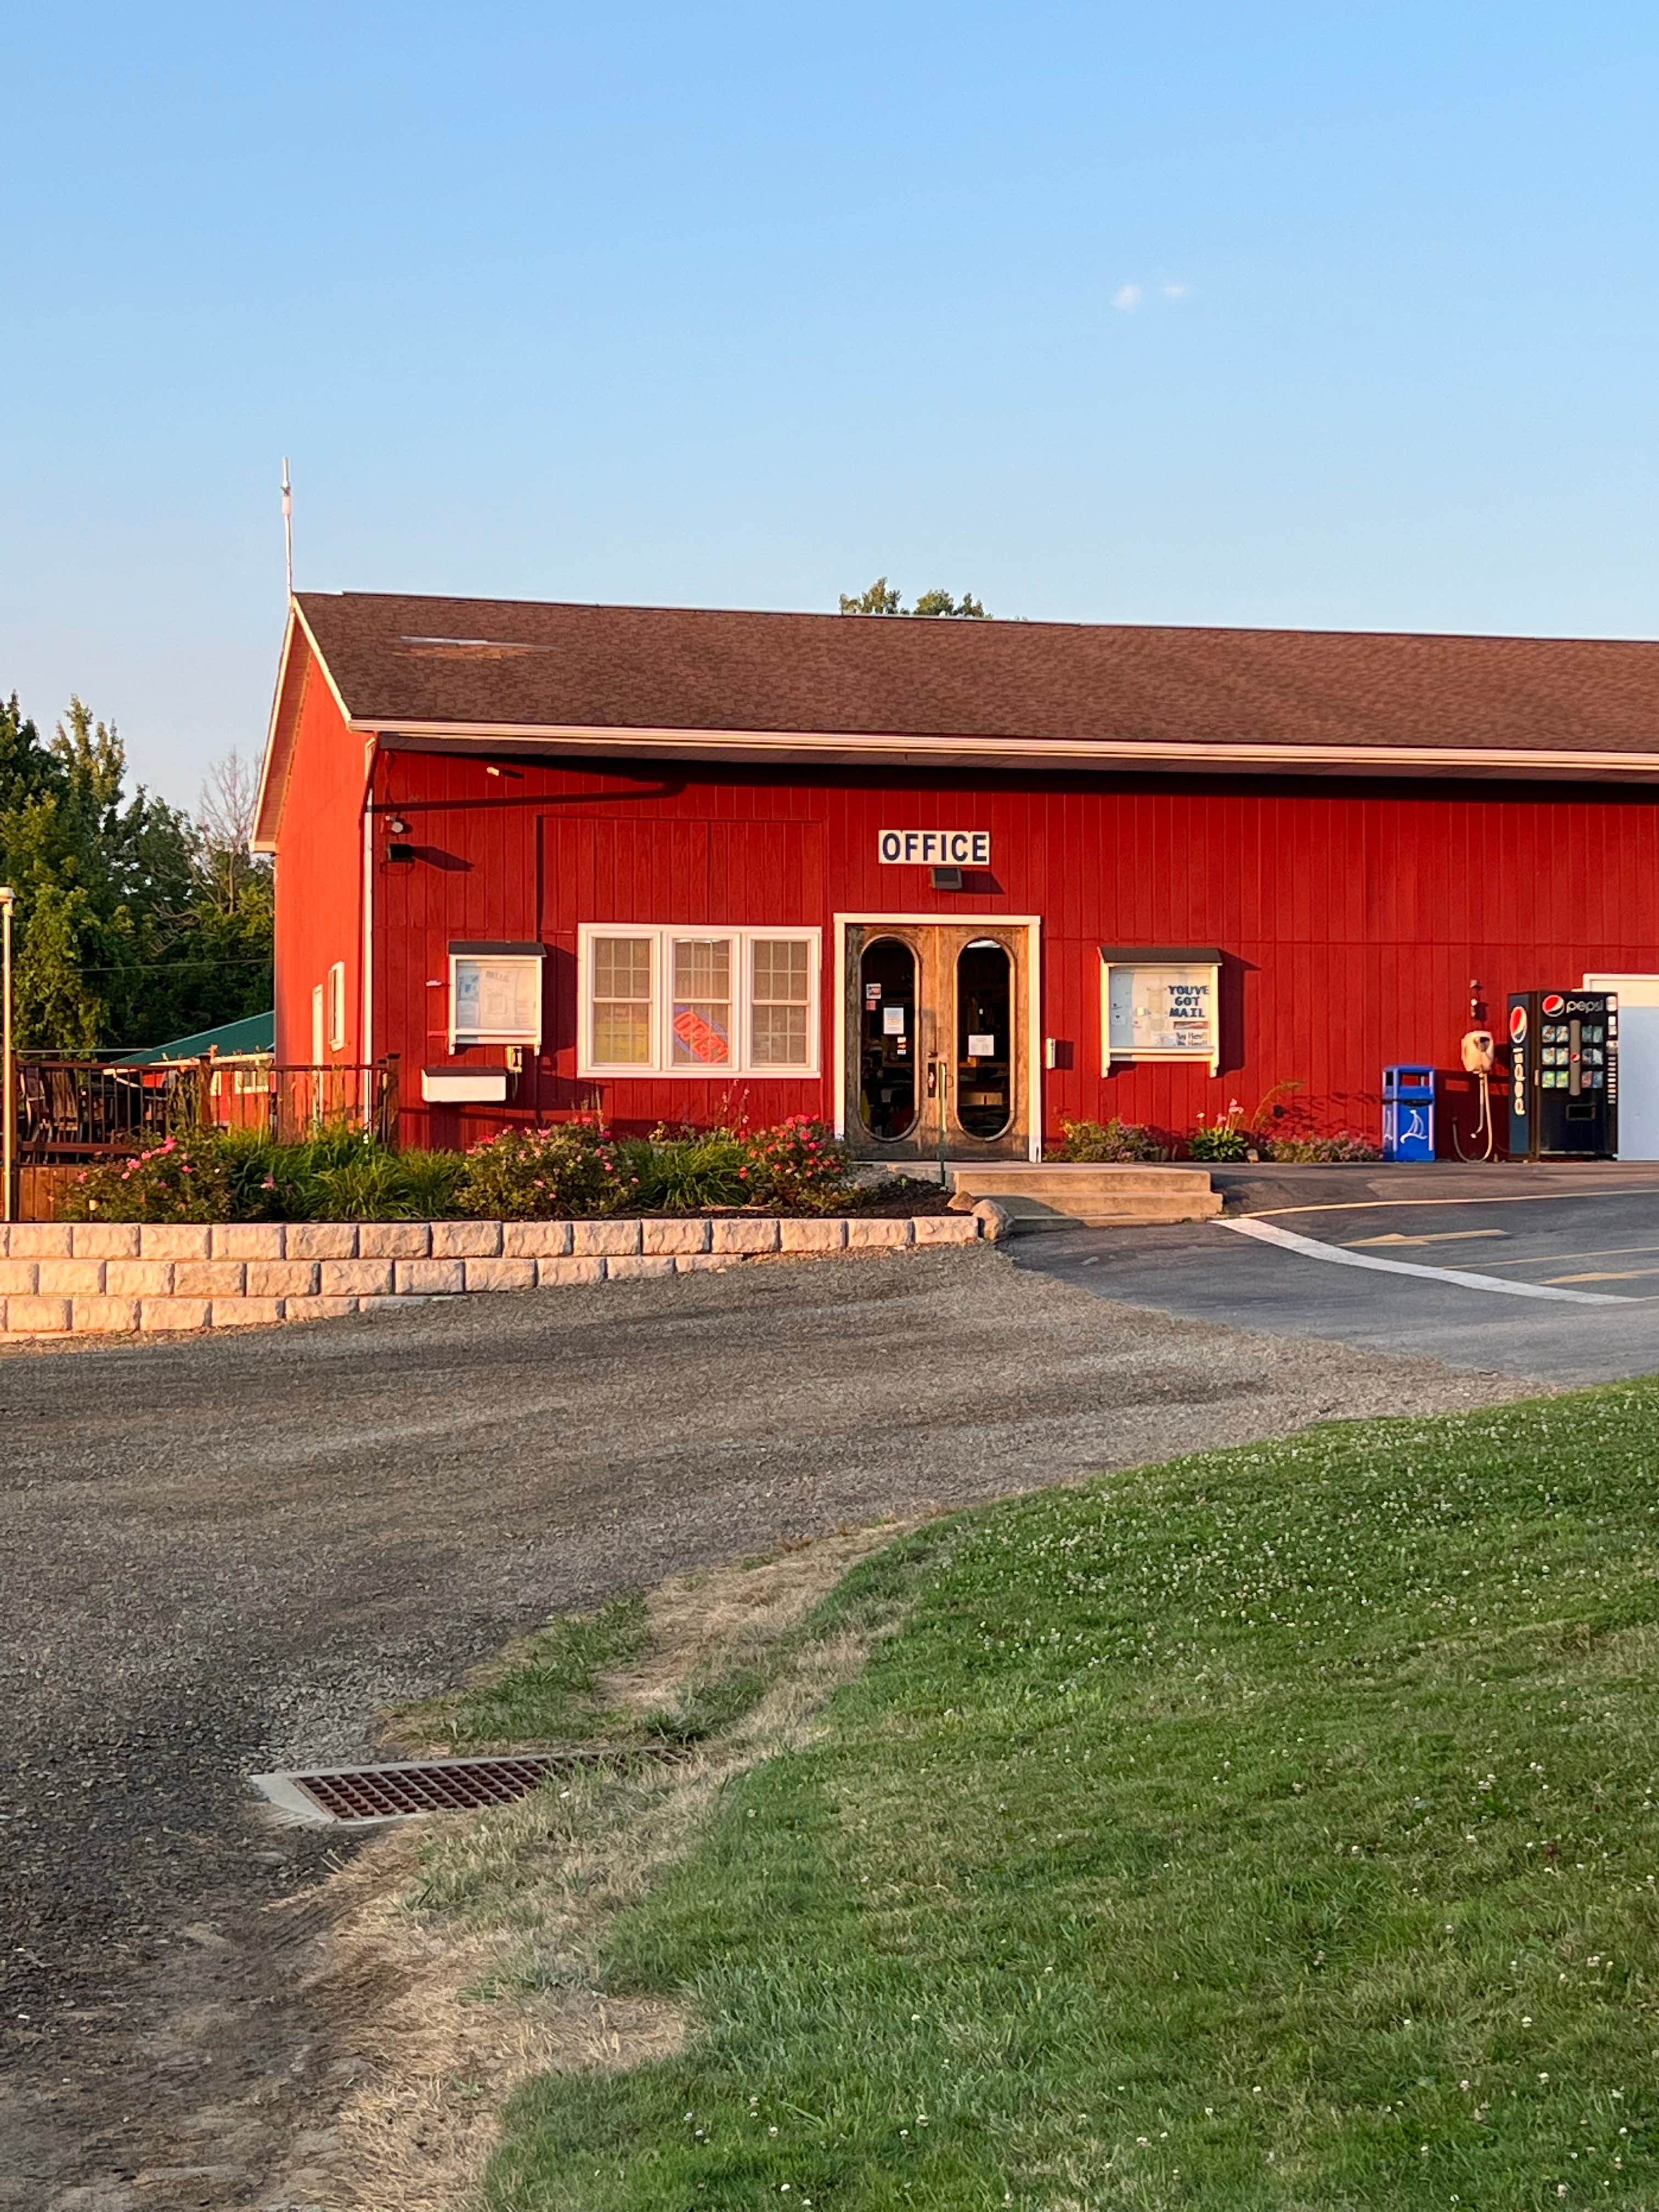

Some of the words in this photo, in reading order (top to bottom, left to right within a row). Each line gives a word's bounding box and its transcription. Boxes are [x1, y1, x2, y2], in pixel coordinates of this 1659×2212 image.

[883, 833, 987, 861] OFFICE
[1175, 996, 1200, 1006] GOT
[1566, 999, 1604, 1013] pepsi
[1169, 1008, 1205, 1018] MAIL
[673, 1011, 729, 1063] OPEN
